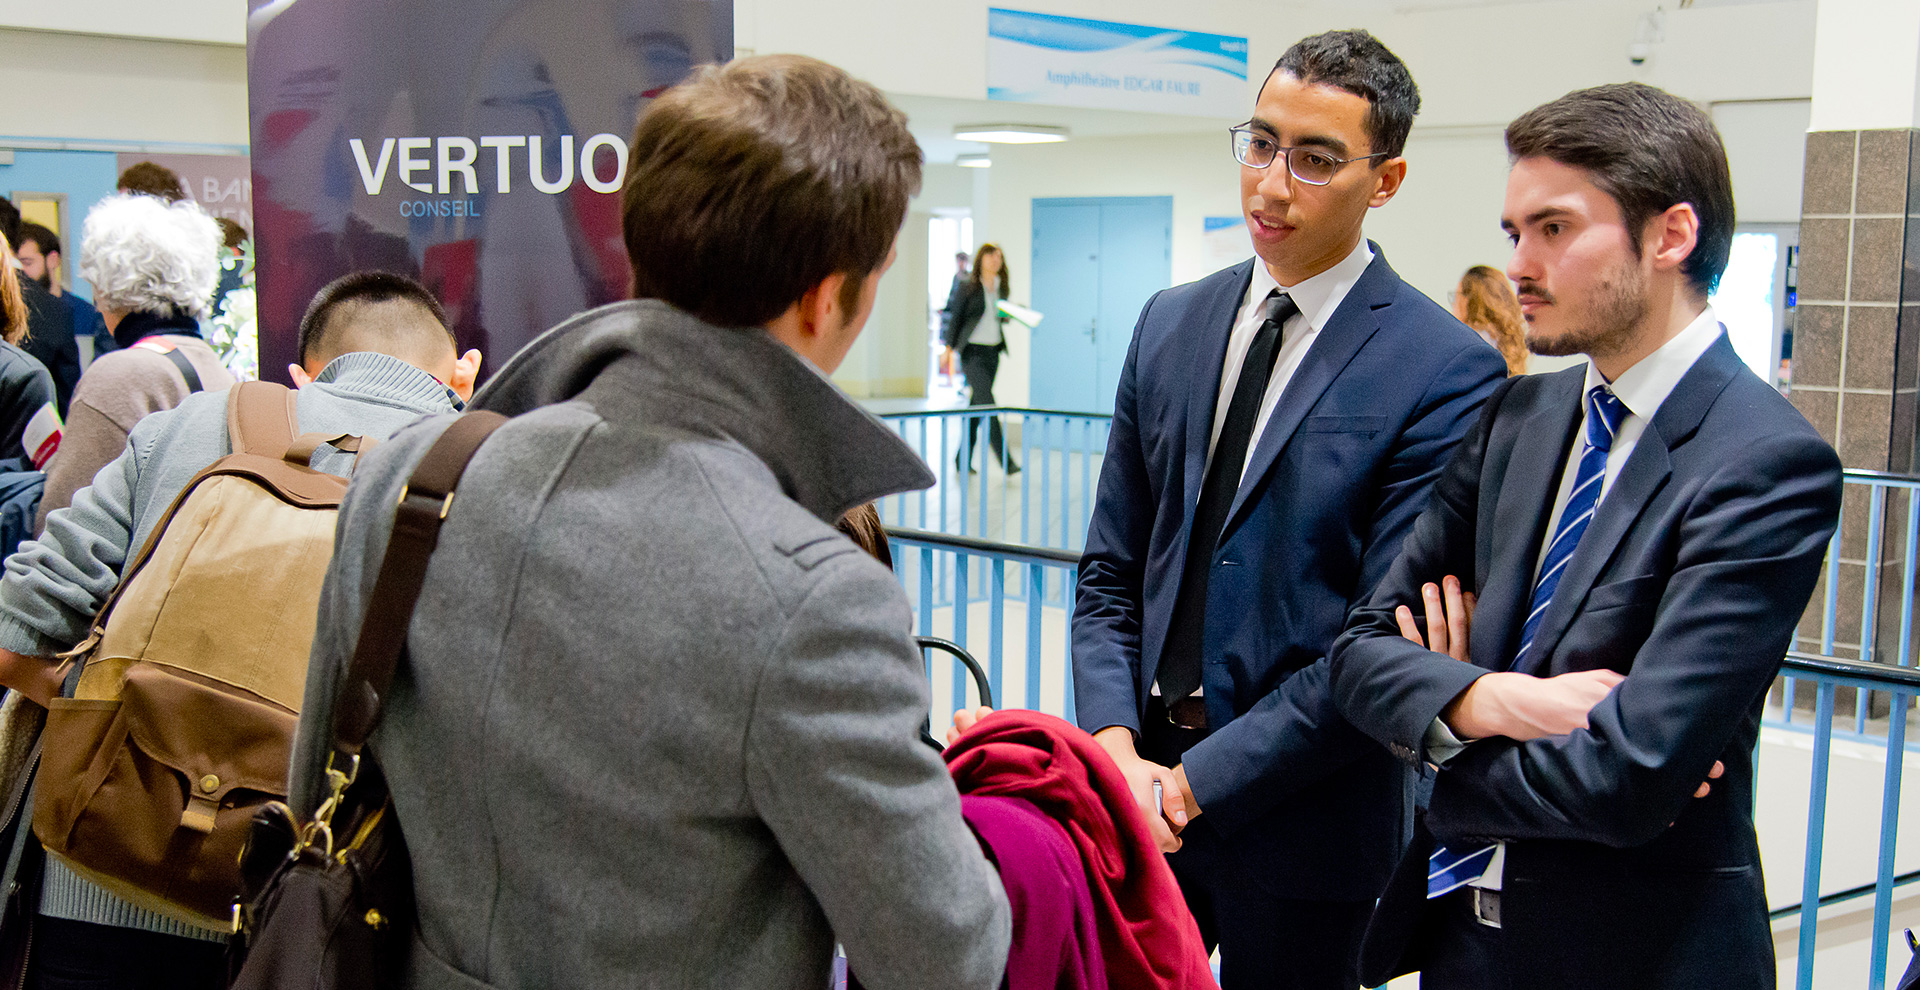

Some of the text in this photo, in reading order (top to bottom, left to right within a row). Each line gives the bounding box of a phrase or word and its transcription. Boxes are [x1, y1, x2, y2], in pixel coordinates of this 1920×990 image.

[1123, 76, 1163, 92] EDGAR
[1166, 80, 1200, 96] FAURE
[349, 133, 629, 195] VERTUO
[400, 200, 480, 217] CONSEIL
